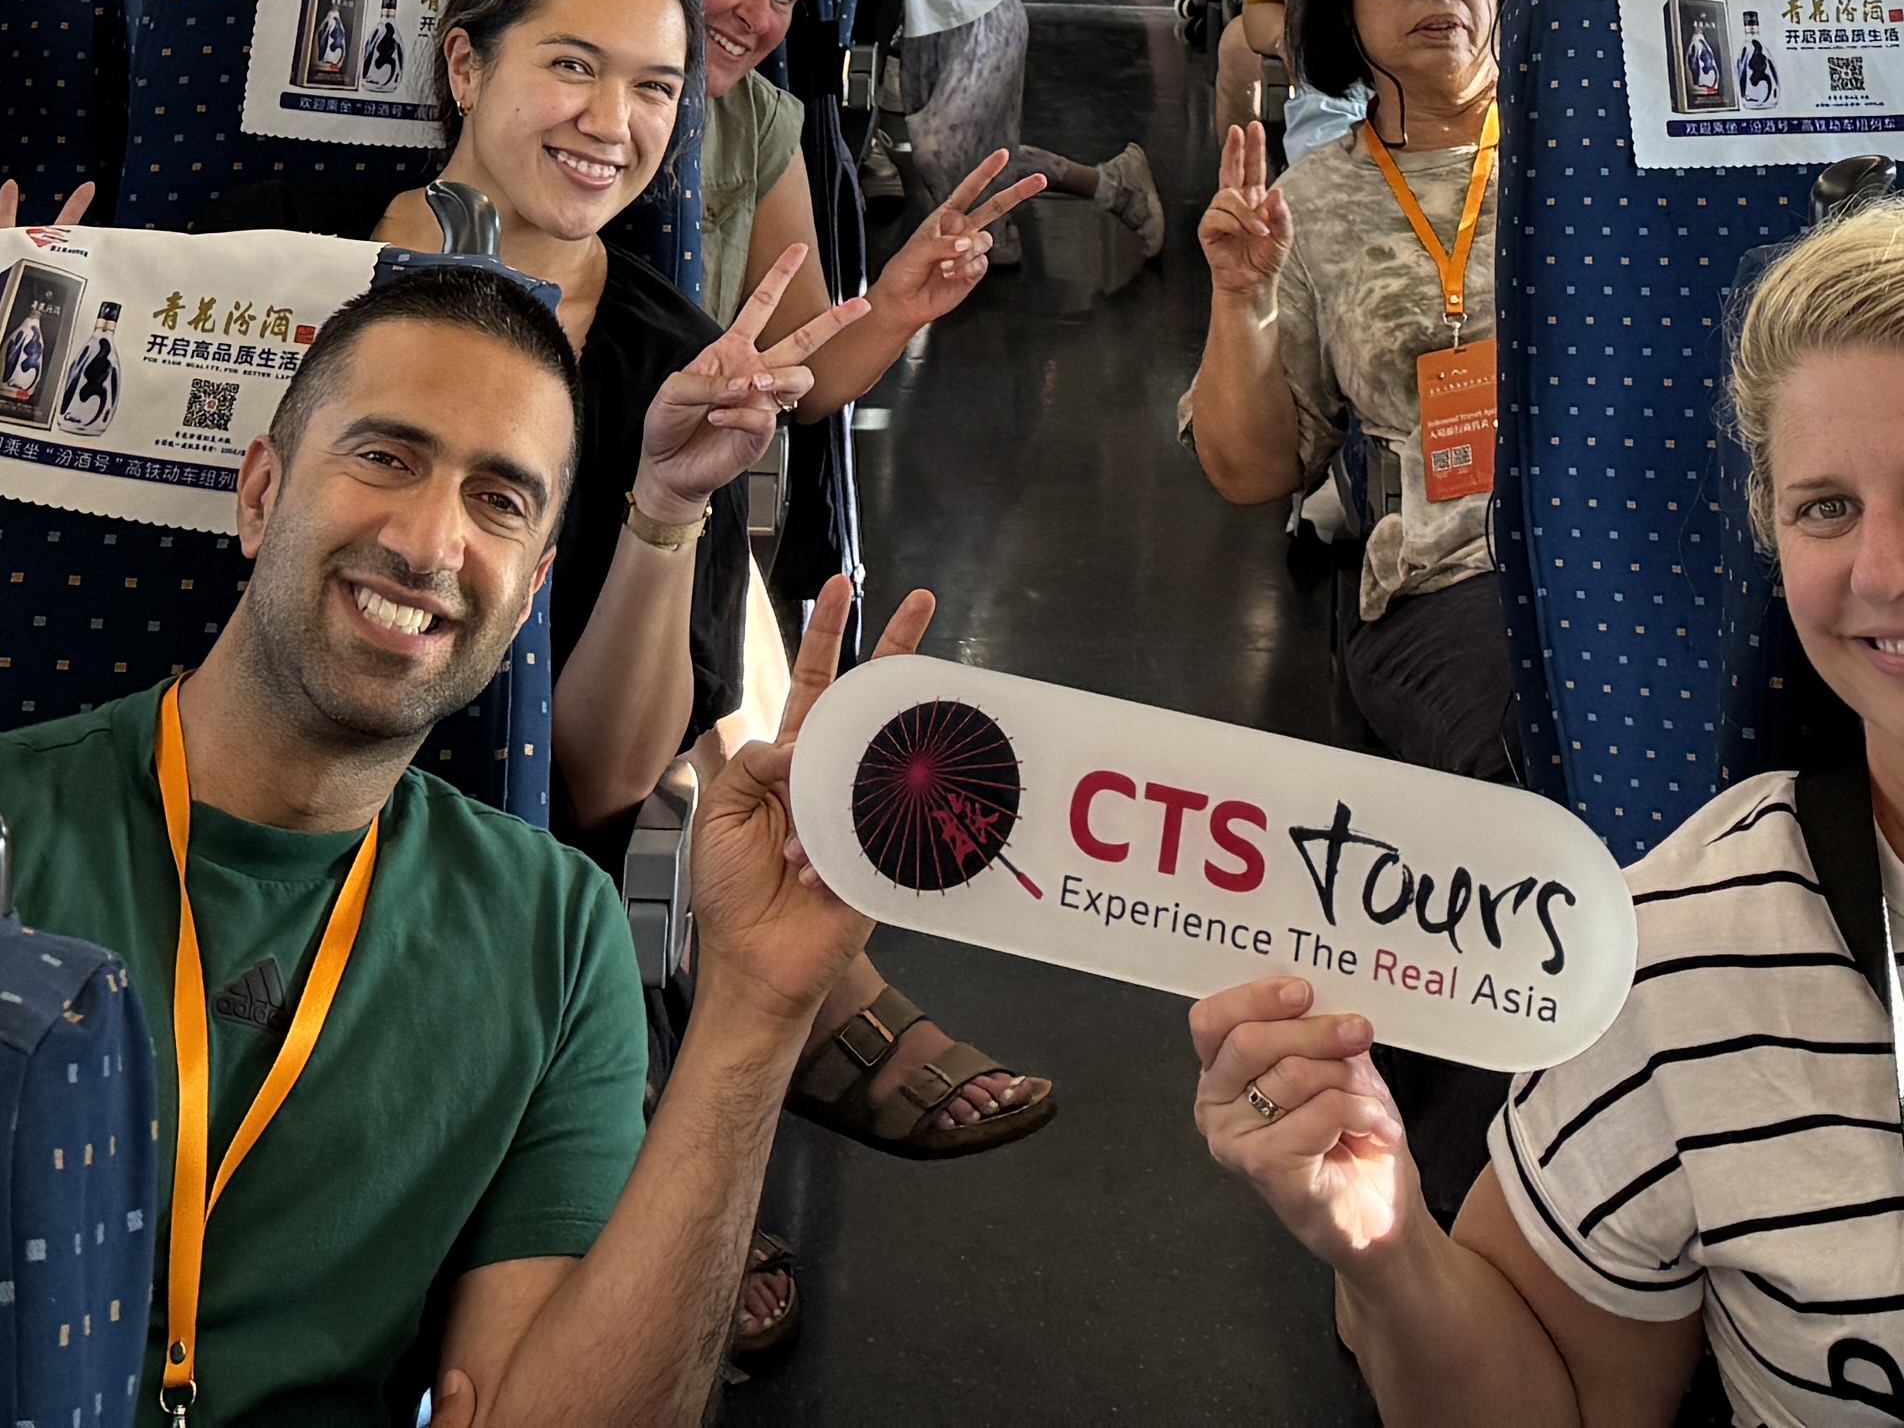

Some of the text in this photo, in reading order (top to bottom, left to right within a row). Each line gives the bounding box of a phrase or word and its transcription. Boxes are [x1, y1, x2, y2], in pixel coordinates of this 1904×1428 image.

[146, 334, 301, 372] 开启高品质生活
[153, 291, 293, 343] 青花汾酒
[1069, 771, 1576, 975] CTS tours
[1060, 875, 1558, 1024] Experience The Real Asia
